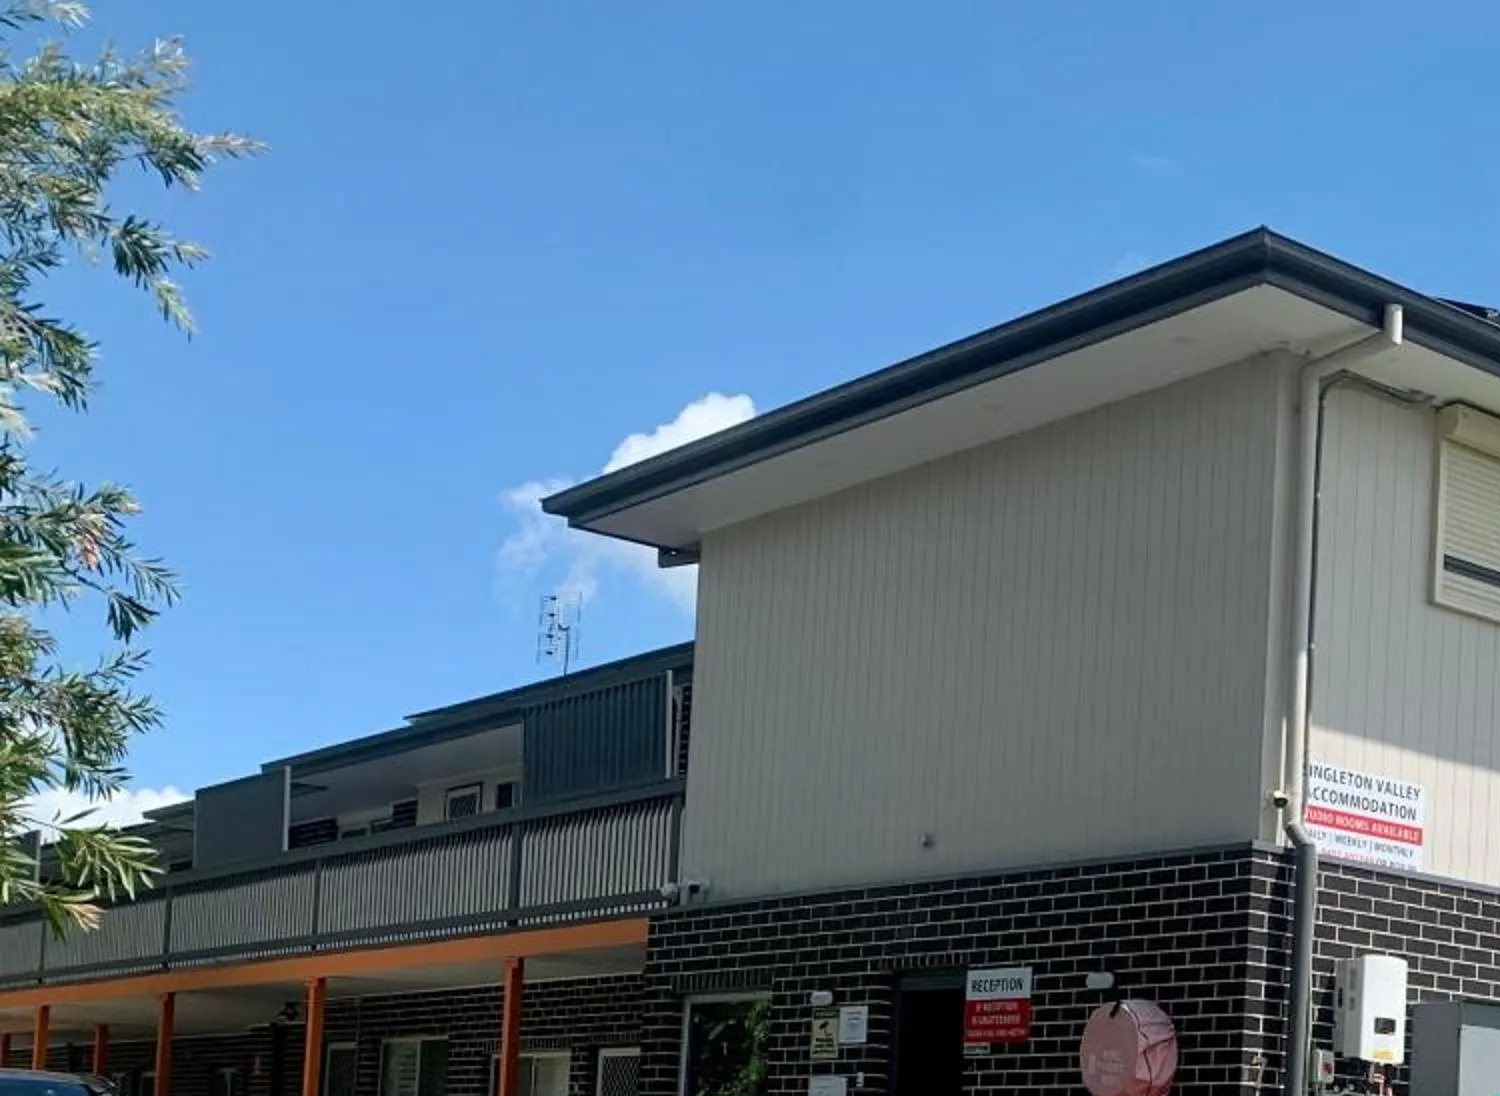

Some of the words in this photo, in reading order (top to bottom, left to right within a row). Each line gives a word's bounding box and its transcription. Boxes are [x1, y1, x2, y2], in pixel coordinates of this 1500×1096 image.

[1307, 763, 1373, 791] INGLETON
[1376, 778, 1421, 801] VALLEY
[1309, 786, 1417, 821] CCOMMODATION
[971, 977, 1025, 993] RECEPTION
